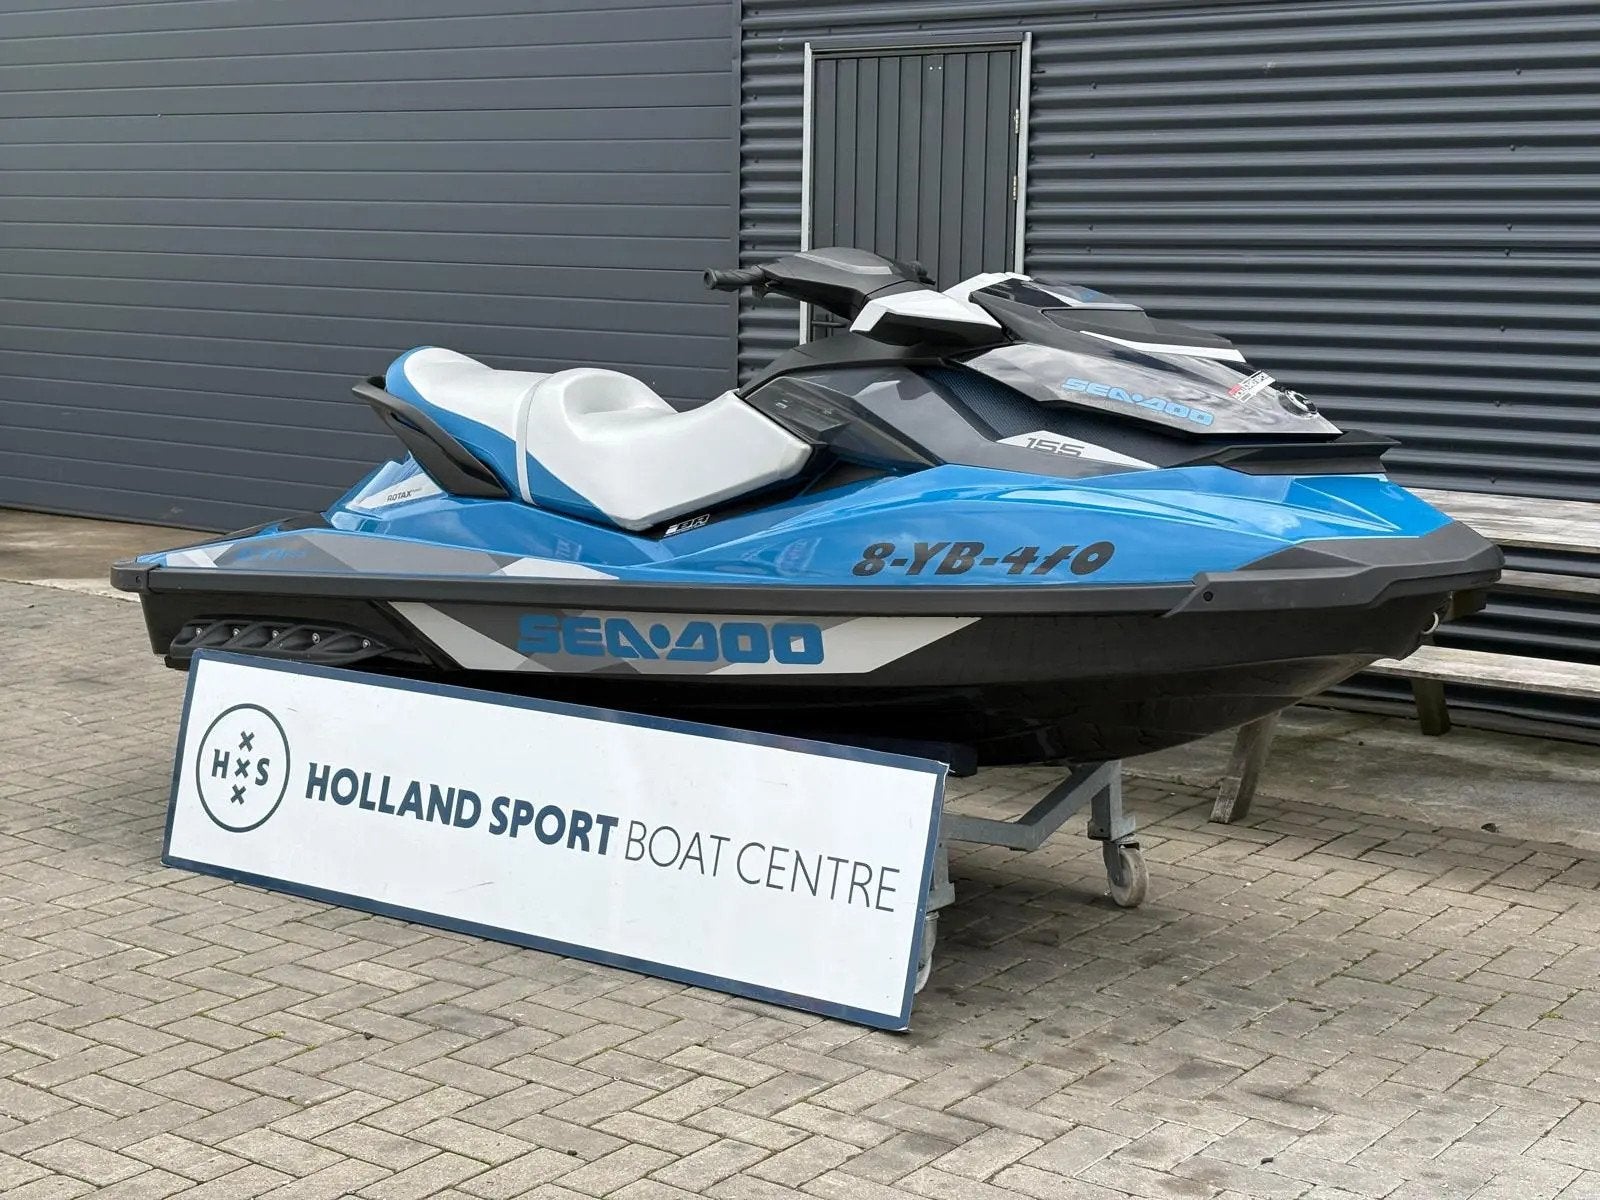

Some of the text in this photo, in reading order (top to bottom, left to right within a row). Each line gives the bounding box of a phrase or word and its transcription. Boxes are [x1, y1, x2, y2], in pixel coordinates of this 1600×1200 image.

[1027, 437, 1086, 458] 155
[386, 490, 412, 502] ROTAX
[305, 762, 900, 912] HOLLAND SPORT BOAT CENTRE
